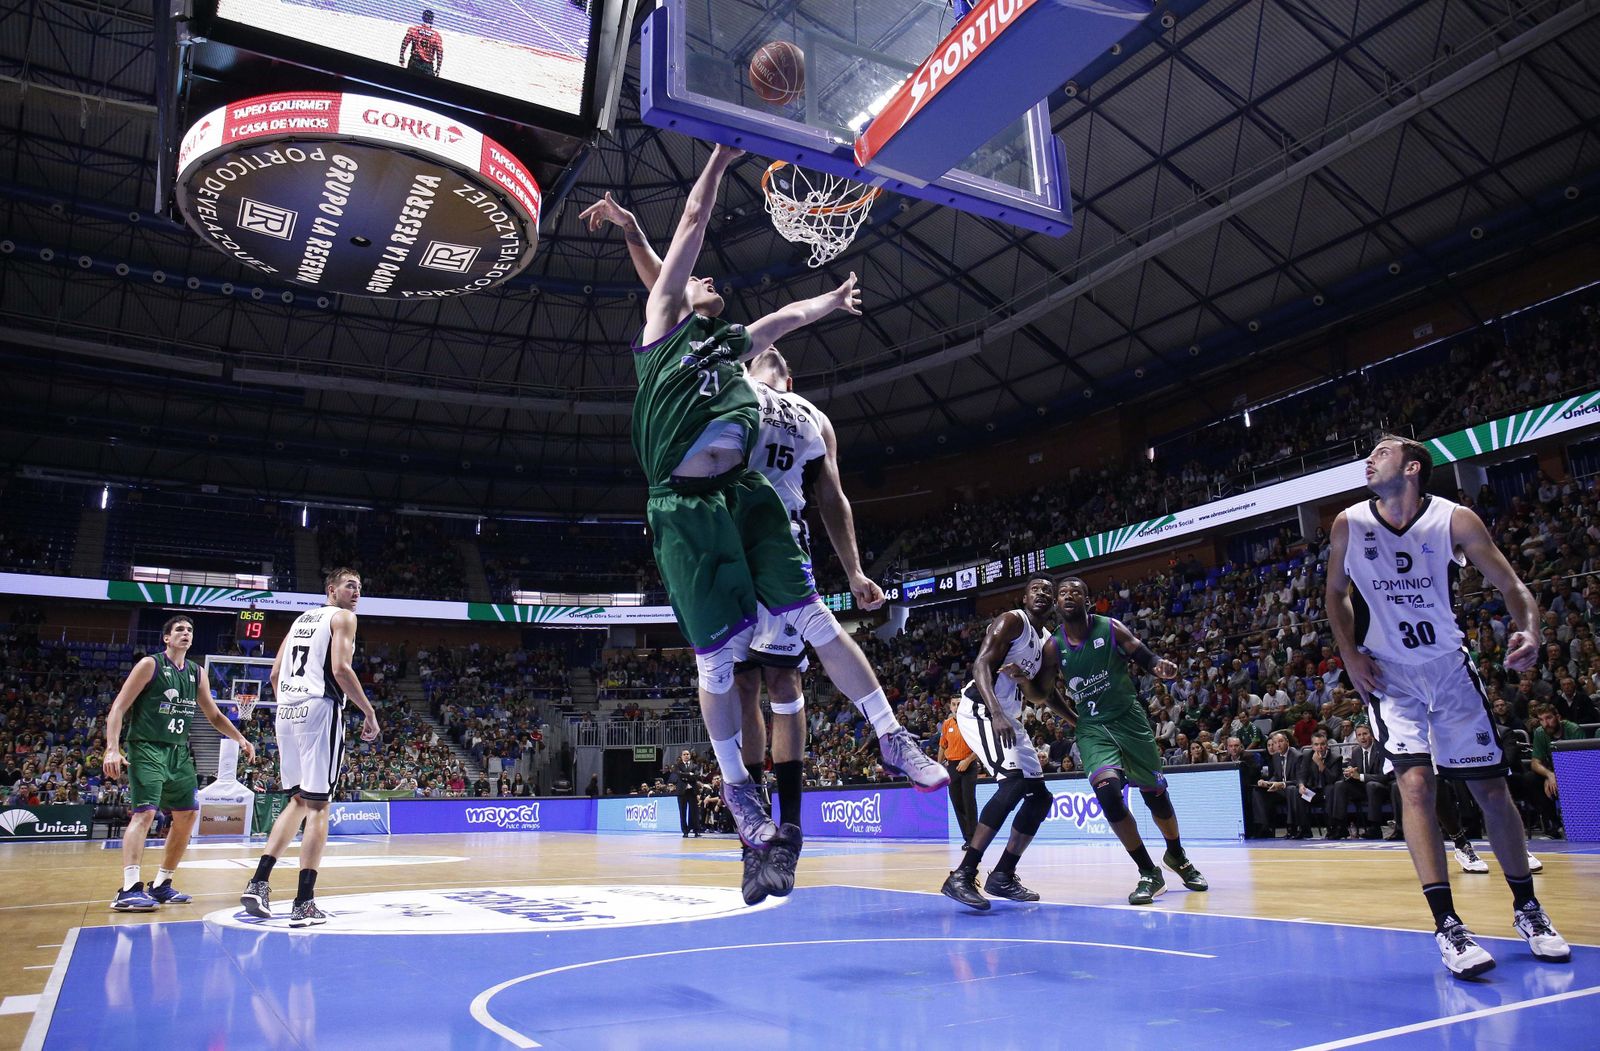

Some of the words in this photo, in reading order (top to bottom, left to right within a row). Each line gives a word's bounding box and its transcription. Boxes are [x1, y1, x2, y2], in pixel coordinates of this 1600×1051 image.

[899, 0, 1024, 129] SPORTIU
[232, 104, 267, 120] TAPEO
[268, 99, 332, 112] GOURMET
[231, 127, 239, 138] Y
[239, 121, 268, 136] CASA
[270, 118, 288, 130] DE
[287, 117, 329, 129] VINOS
[362, 109, 442, 142] GORKI
[216, 147, 327, 182] PORTICO
[489, 164, 496, 176] Y
[490, 147, 515, 175] TAPEO
[198, 176, 226, 200] DE
[318, 154, 359, 216] GRUPO
[390, 174, 442, 246] RESERVA
[311, 217, 341, 238] LA
[453, 184, 520, 261] VELAZQUEZ
[197, 197, 280, 275] VELAZQUEZ
[296, 236, 334, 284] RESERVA
[382, 246, 411, 263] LA
[366, 262, 402, 294] GRUPO
[493, 261, 512, 279] DE
[401, 278, 492, 298] PORTICO
[698, 369, 720, 397] 21
[765, 443, 795, 472] 15
[1139, 527, 1164, 538] Unicaja
[1164, 522, 1178, 531] Obra
[1178, 518, 1194, 528] Social
[940, 577, 953, 590] 48
[884, 589, 899, 601] 48
[240, 610, 265, 621] 06:05
[246, 622, 262, 638] 19
[1399, 621, 1436, 650] 30
[765, 643, 794, 652] CORREO
[291, 645, 310, 678] 17
[1083, 669, 1109, 687] Unicaja
[1087, 700, 1100, 716] 2
[168, 718, 185, 734] 43
[1460, 755, 1493, 764] CORREO
[465, 802, 540, 828] mayoral
[626, 799, 658, 826] mayoral
[821, 792, 881, 830] mayoral
[35, 820, 88, 835] Unicaja
[521, 823, 541, 831] amigos
[852, 824, 865, 833] hace
[865, 824, 882, 836] amigos
[1087, 822, 1107, 834] hace
